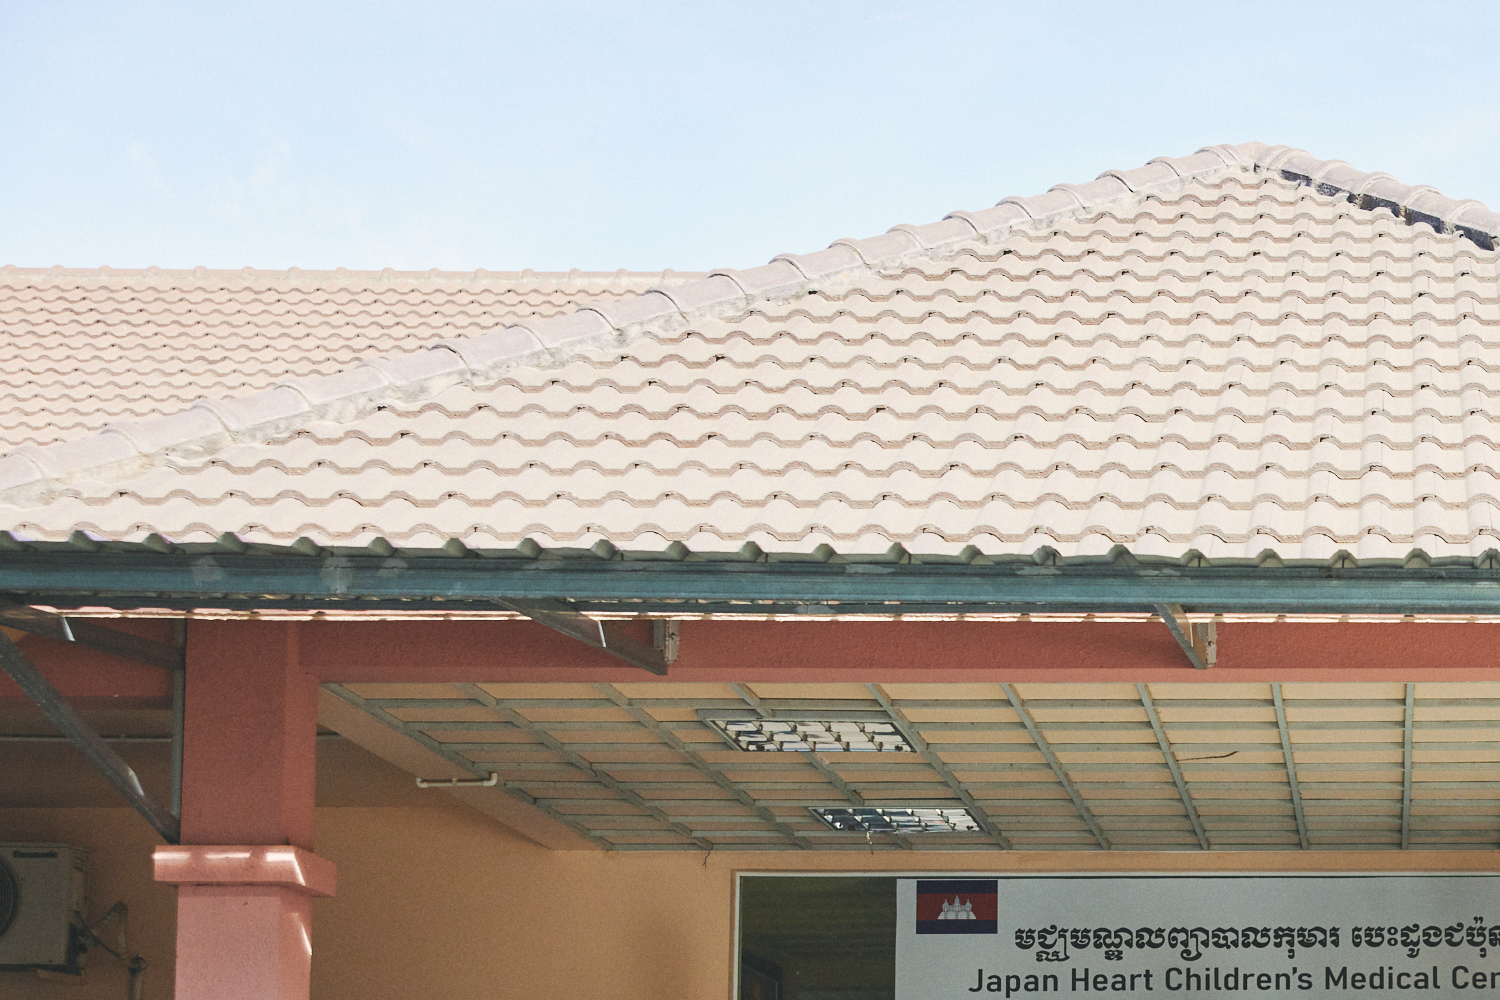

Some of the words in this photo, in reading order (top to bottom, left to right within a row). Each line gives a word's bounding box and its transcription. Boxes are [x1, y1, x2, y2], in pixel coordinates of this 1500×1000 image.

[968, 967, 1059, 999] Japan
[1071, 967, 1154, 992] Heart
[1165, 966, 1313, 991] Children's
[1325, 965, 1441, 990] Medical
